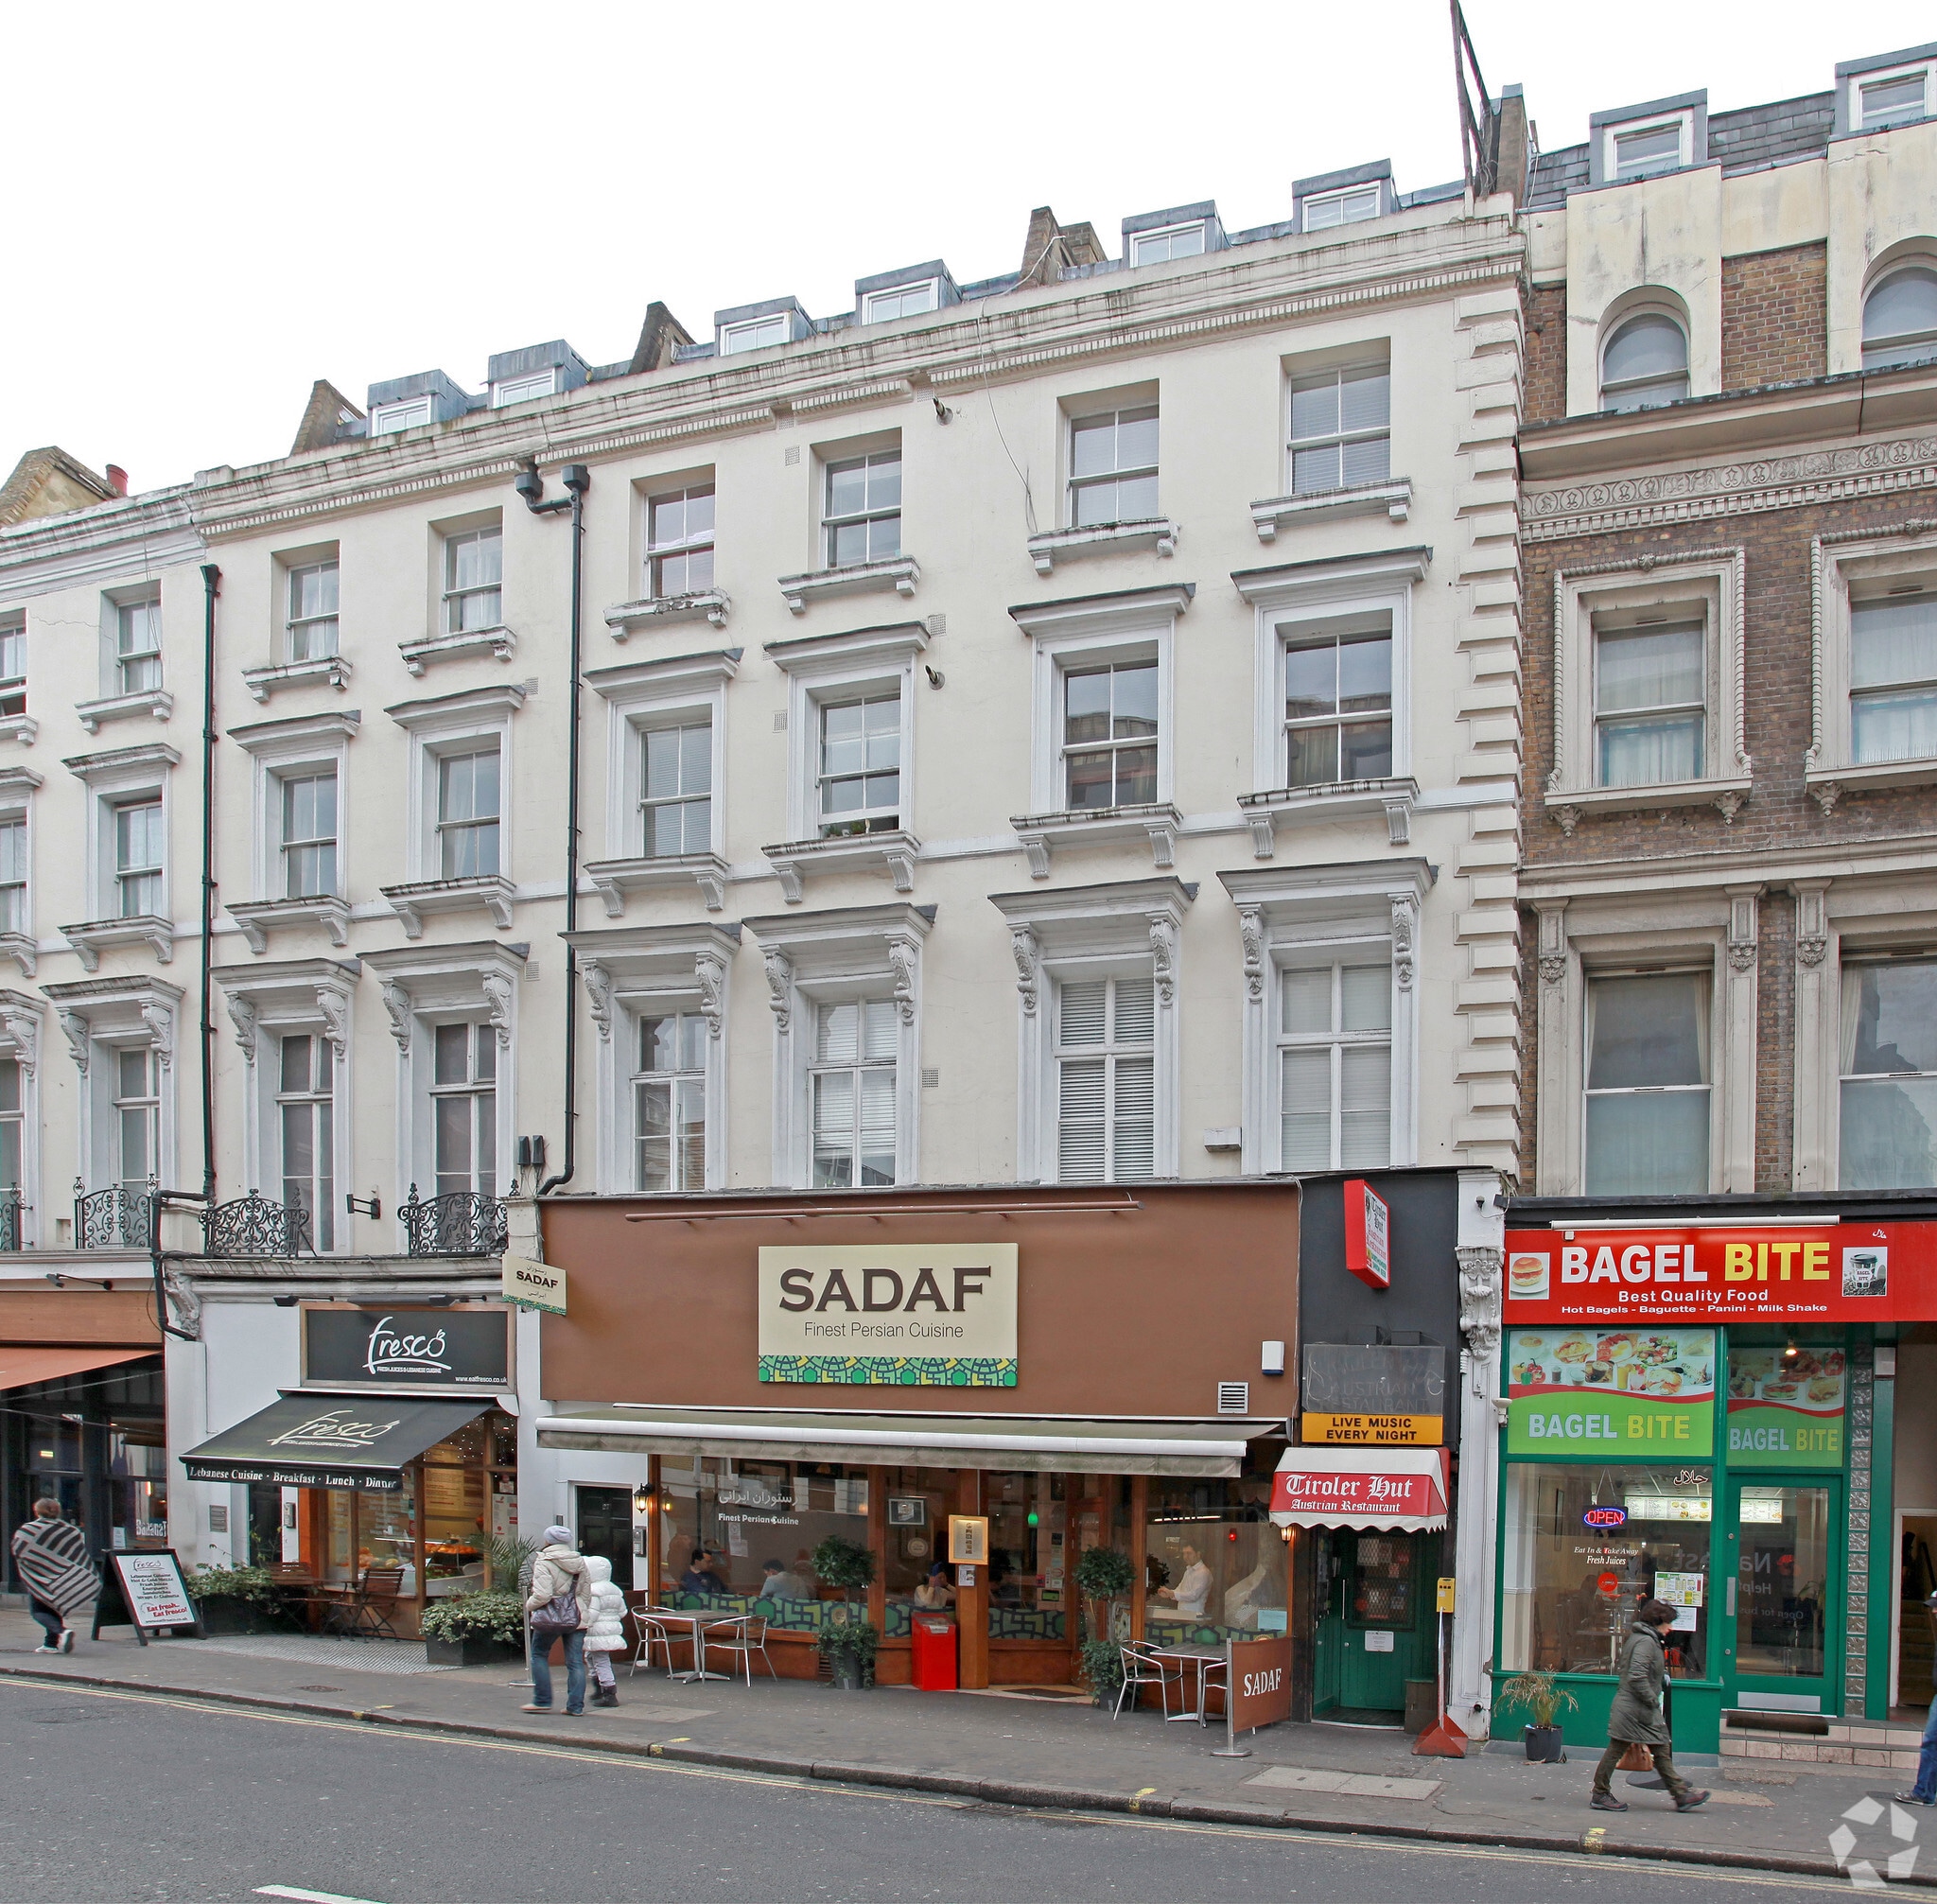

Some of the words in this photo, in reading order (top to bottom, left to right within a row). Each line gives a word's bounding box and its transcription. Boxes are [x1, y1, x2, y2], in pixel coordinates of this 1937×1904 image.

[1561, 1245, 1708, 1284] BAGEL
[1724, 1242, 1830, 1282] BITE
[516, 1270, 559, 1288] SADAF
[779, 1266, 991, 1312] SADAF
[1618, 1290, 1656, 1302] Best
[1661, 1289, 1722, 1304] Quality
[1727, 1289, 1769, 1301] Food
[1562, 1305, 1584, 1314] Hot
[1587, 1305, 1629, 1315] Bagels
[1639, 1305, 1697, 1315] Baguette
[1707, 1304, 1747, 1313] Panini
[1788, 1303, 1827, 1312] Shake
[804, 1322, 846, 1337] Finest
[851, 1322, 904, 1337] Persian
[909, 1322, 964, 1337] Cuisine
[1332, 1418, 1362, 1427] LIVE
[1369, 1418, 1412, 1428] MUSIC
[1528, 1413, 1618, 1439] BAGEL
[1627, 1414, 1690, 1440] BITE
[1326, 1430, 1369, 1440] EVERY
[1376, 1431, 1417, 1441] NIGHT
[1729, 1427, 1789, 1451] BAGEL
[1795, 1428, 1839, 1452] BITE
[190, 1466, 229, 1479] Lebanese
[231, 1469, 263, 1480] Cuisine
[273, 1472, 315, 1484] Breakfast
[325, 1475, 355, 1486] Lunch
[365, 1476, 396, 1488] Dinner
[1673, 1469, 1708, 1486] حلال
[1286, 1475, 1361, 1495] Tiroler
[1367, 1476, 1413, 1501] Hut
[753, 1492, 798, 1507] رستوران
[1290, 1498, 1337, 1511] Austrian
[1340, 1500, 1401, 1512] Restaurant
[718, 1513, 741, 1522] Finest
[742, 1514, 770, 1523] Persian
[772, 1516, 799, 1525] Cuisine
[1587, 1510, 1623, 1525] OPEN
[1620, 1547, 1639, 1556] Away
[1586, 1555, 1605, 1564] Fresh
[1605, 1556, 1627, 1565] Juices
[1244, 1668, 1282, 1697] SADAF
